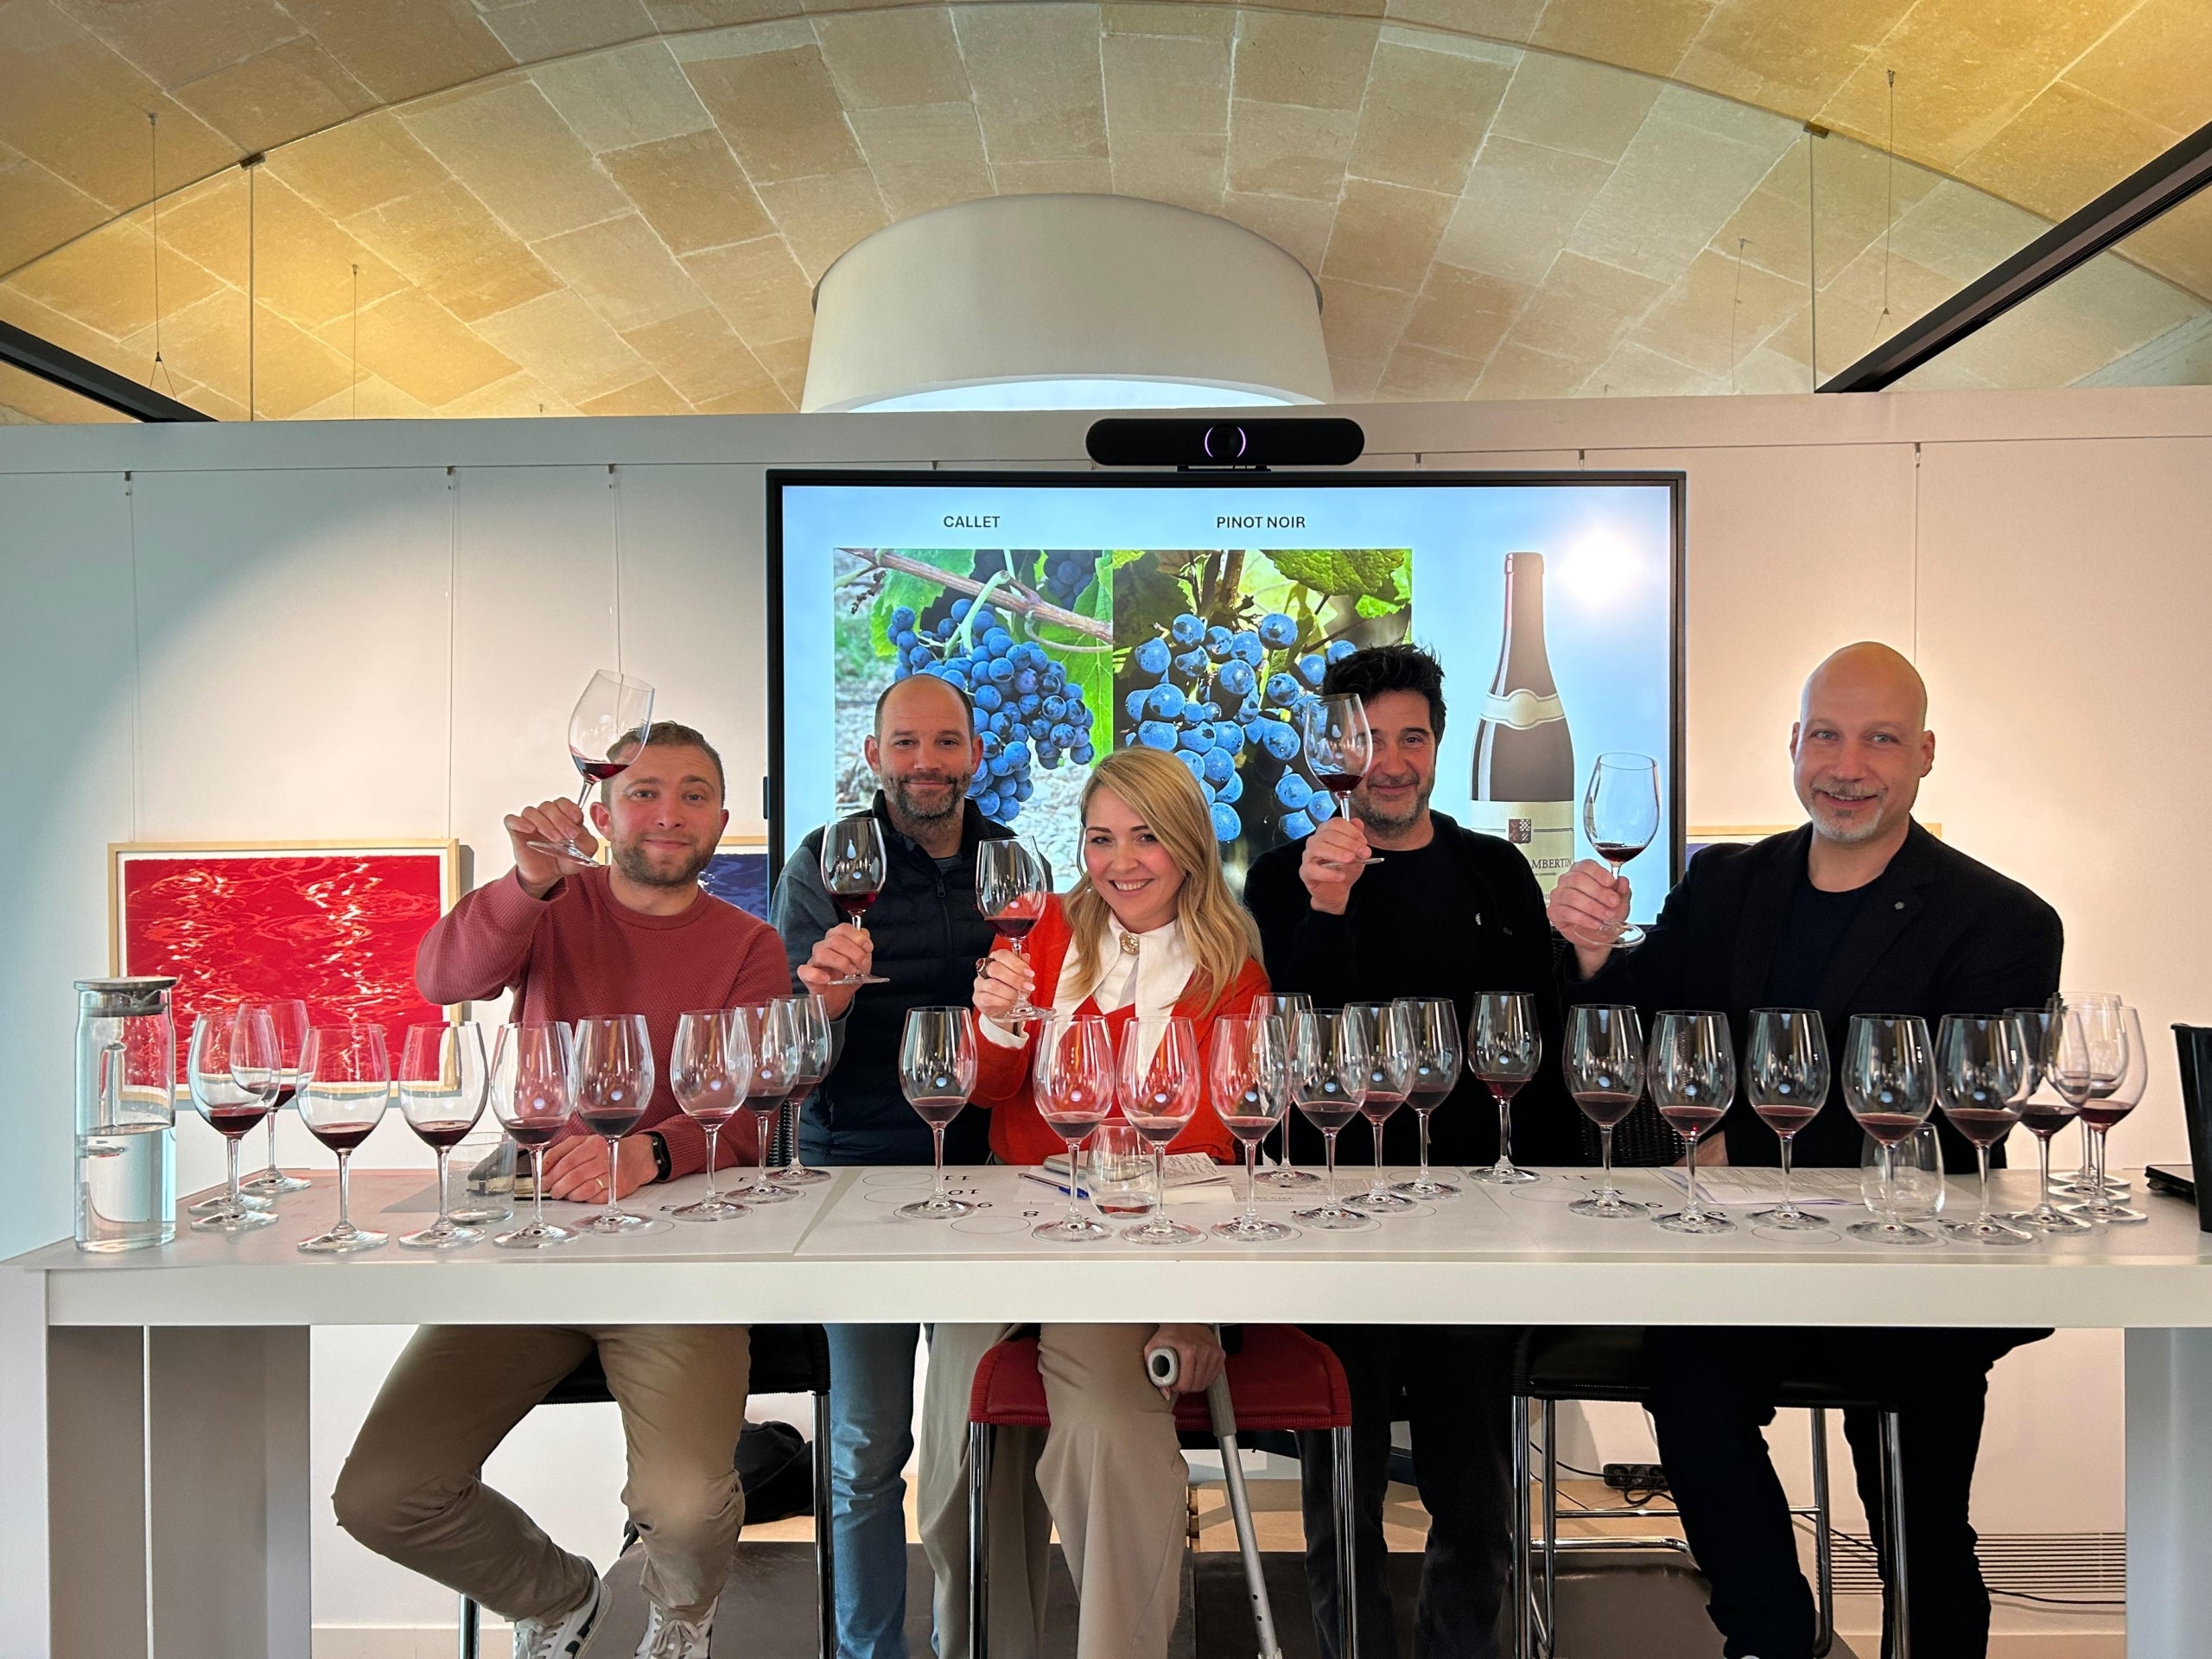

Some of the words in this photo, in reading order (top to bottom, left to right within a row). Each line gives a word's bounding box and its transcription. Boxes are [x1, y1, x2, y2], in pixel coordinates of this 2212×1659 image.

[944, 515, 1001, 528] CALLET
[1217, 516, 1263, 528] PINOT
[1267, 516, 1306, 528] NOIR
[1530, 857, 1573, 869] MBERTIN
